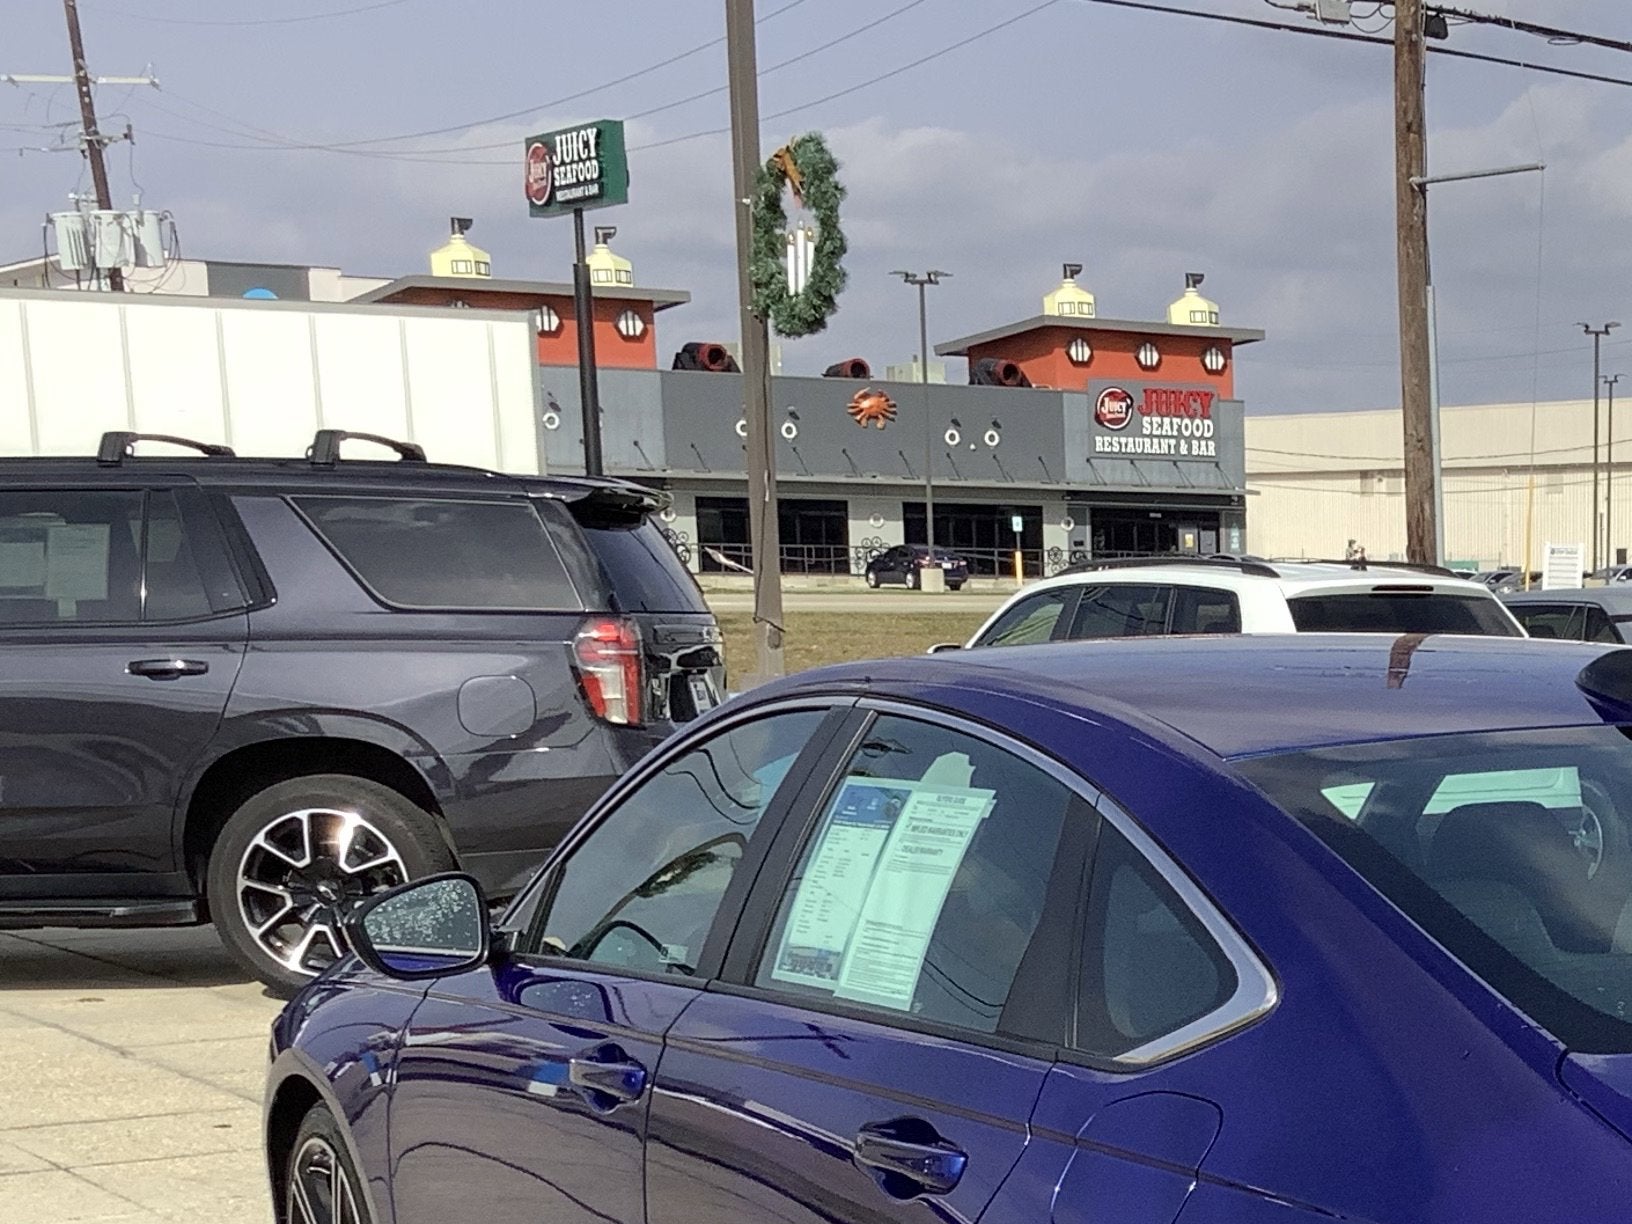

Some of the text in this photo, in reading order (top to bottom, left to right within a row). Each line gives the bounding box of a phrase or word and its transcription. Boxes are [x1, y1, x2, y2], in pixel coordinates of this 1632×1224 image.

[553, 128, 597, 165] JUICY
[553, 159, 599, 186] SEAFOOD
[1137, 388, 1214, 418] JUICY
[1142, 417, 1214, 437] SEAFOOD
[1095, 436, 1215, 456] RESTAURANT & BAR
